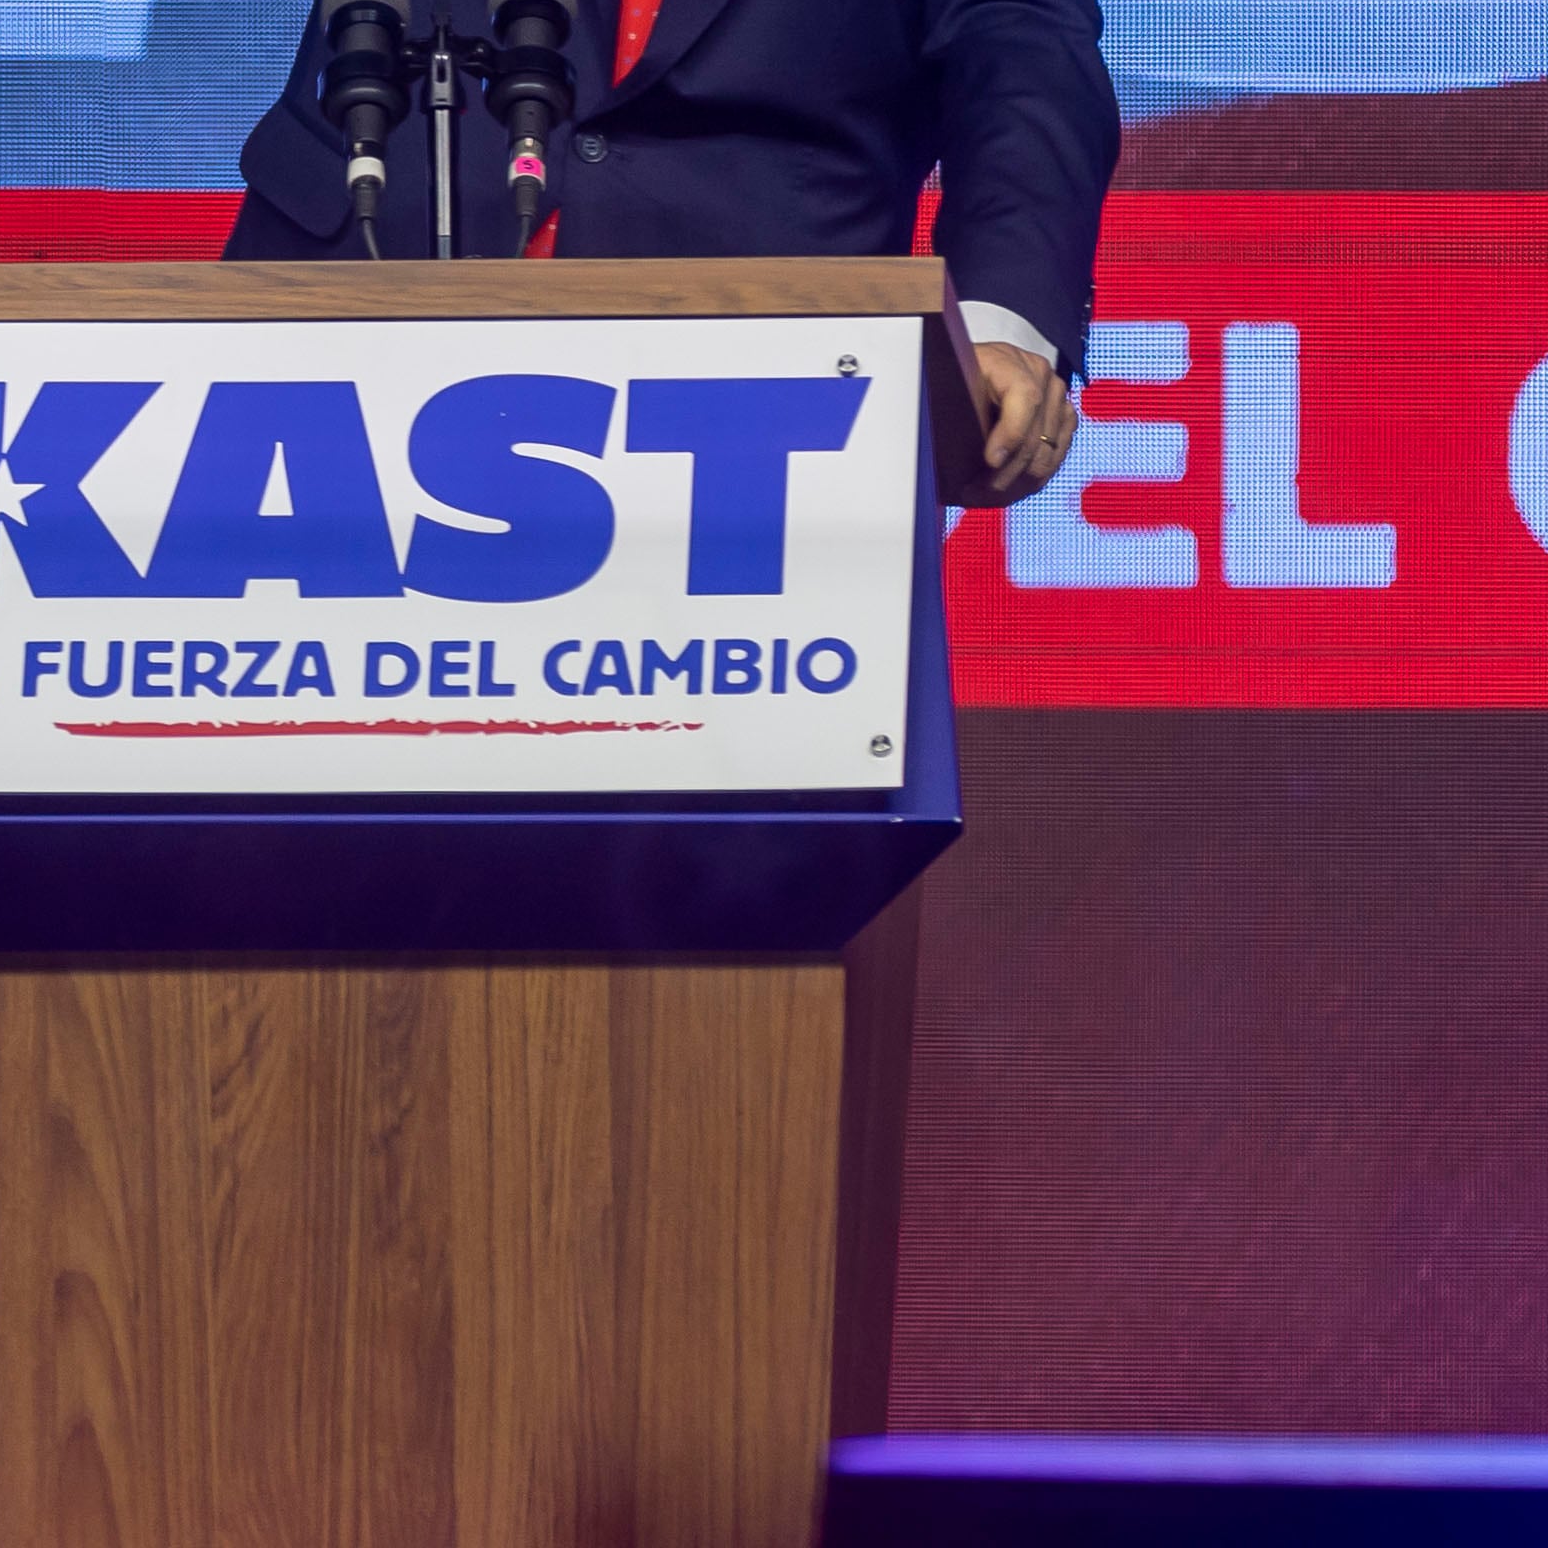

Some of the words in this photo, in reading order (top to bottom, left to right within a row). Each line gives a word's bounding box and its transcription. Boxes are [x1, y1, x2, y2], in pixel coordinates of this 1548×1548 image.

[945, 320, 1397, 589] EL
[22, 640, 335, 698] FUERZA
[363, 640, 515, 698] DEL
[542, 637, 858, 697] CAMBIO
